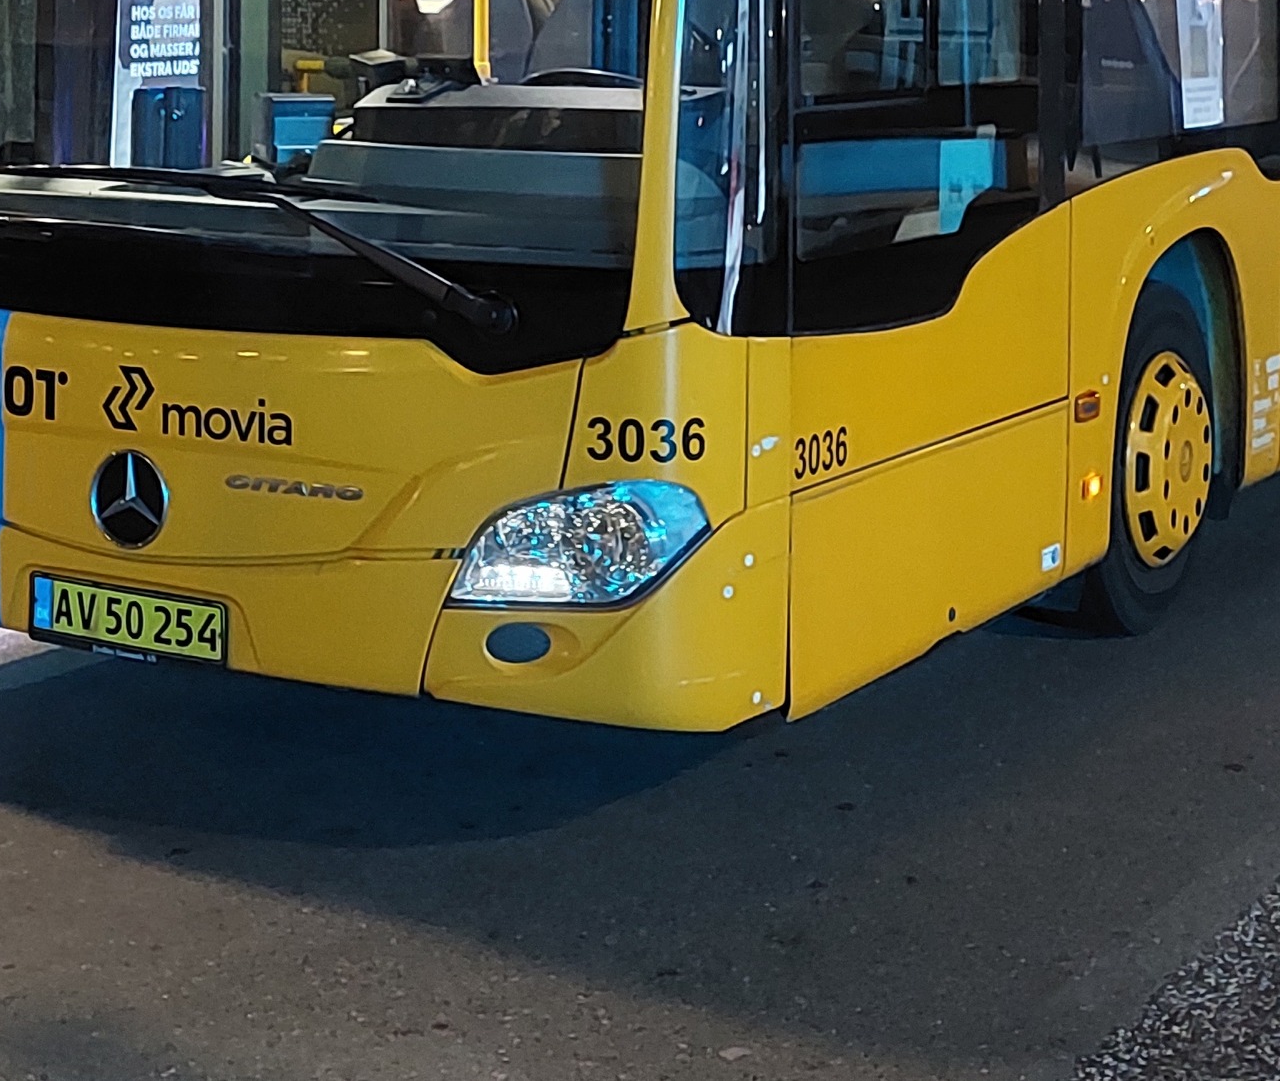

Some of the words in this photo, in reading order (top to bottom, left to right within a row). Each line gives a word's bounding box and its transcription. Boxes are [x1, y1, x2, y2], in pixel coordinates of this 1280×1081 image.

[130, 5, 156, 21] HOS
[158, 5, 173, 20] OS
[175, 2, 195, 20] FÅR
[130, 22, 161, 40] BÅDE
[129, 43, 149, 59] OG
[150, 41, 194, 58] MASSER
[160, 398, 293, 446] movia
[586, 416, 706, 463] 3036
[793, 426, 848, 480] 3036
[54, 588, 97, 631] AV
[105, 596, 144, 640] 50
[153, 605, 217, 652] 254
